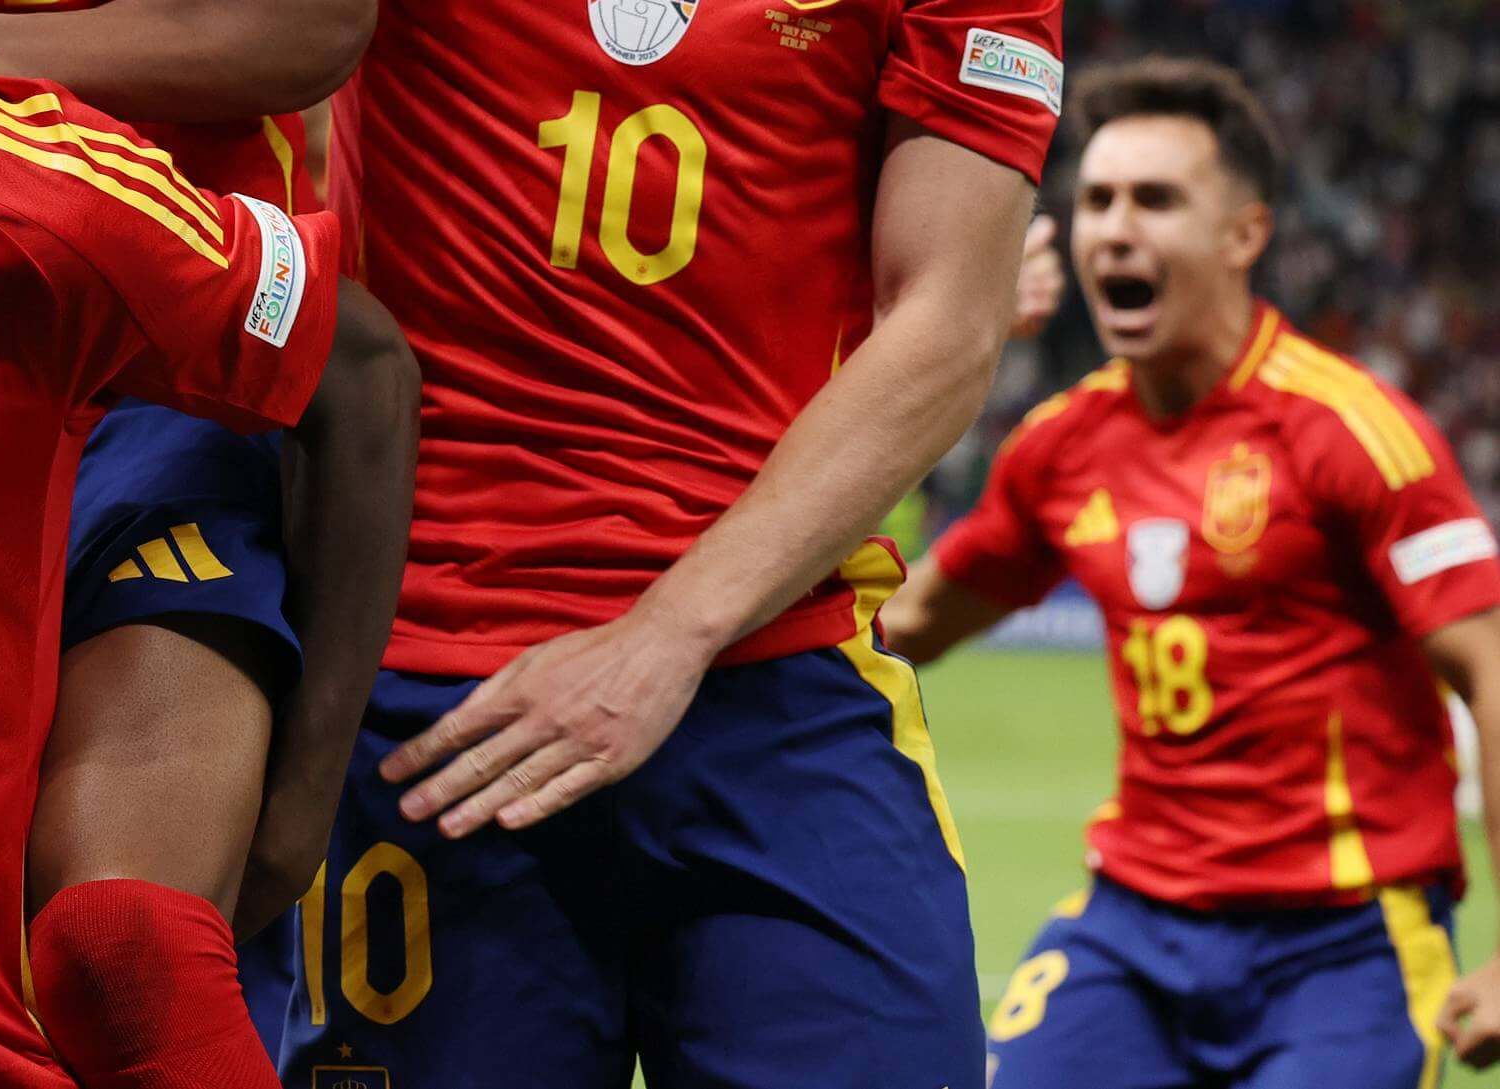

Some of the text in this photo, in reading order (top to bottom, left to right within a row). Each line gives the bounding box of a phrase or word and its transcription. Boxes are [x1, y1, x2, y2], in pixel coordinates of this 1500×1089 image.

[972, 33, 1005, 49] UEFA
[538, 90, 707, 286] 10
[249, 291, 268, 330] UEFA
[1121, 614, 1214, 736] 18
[297, 841, 433, 1025] 10
